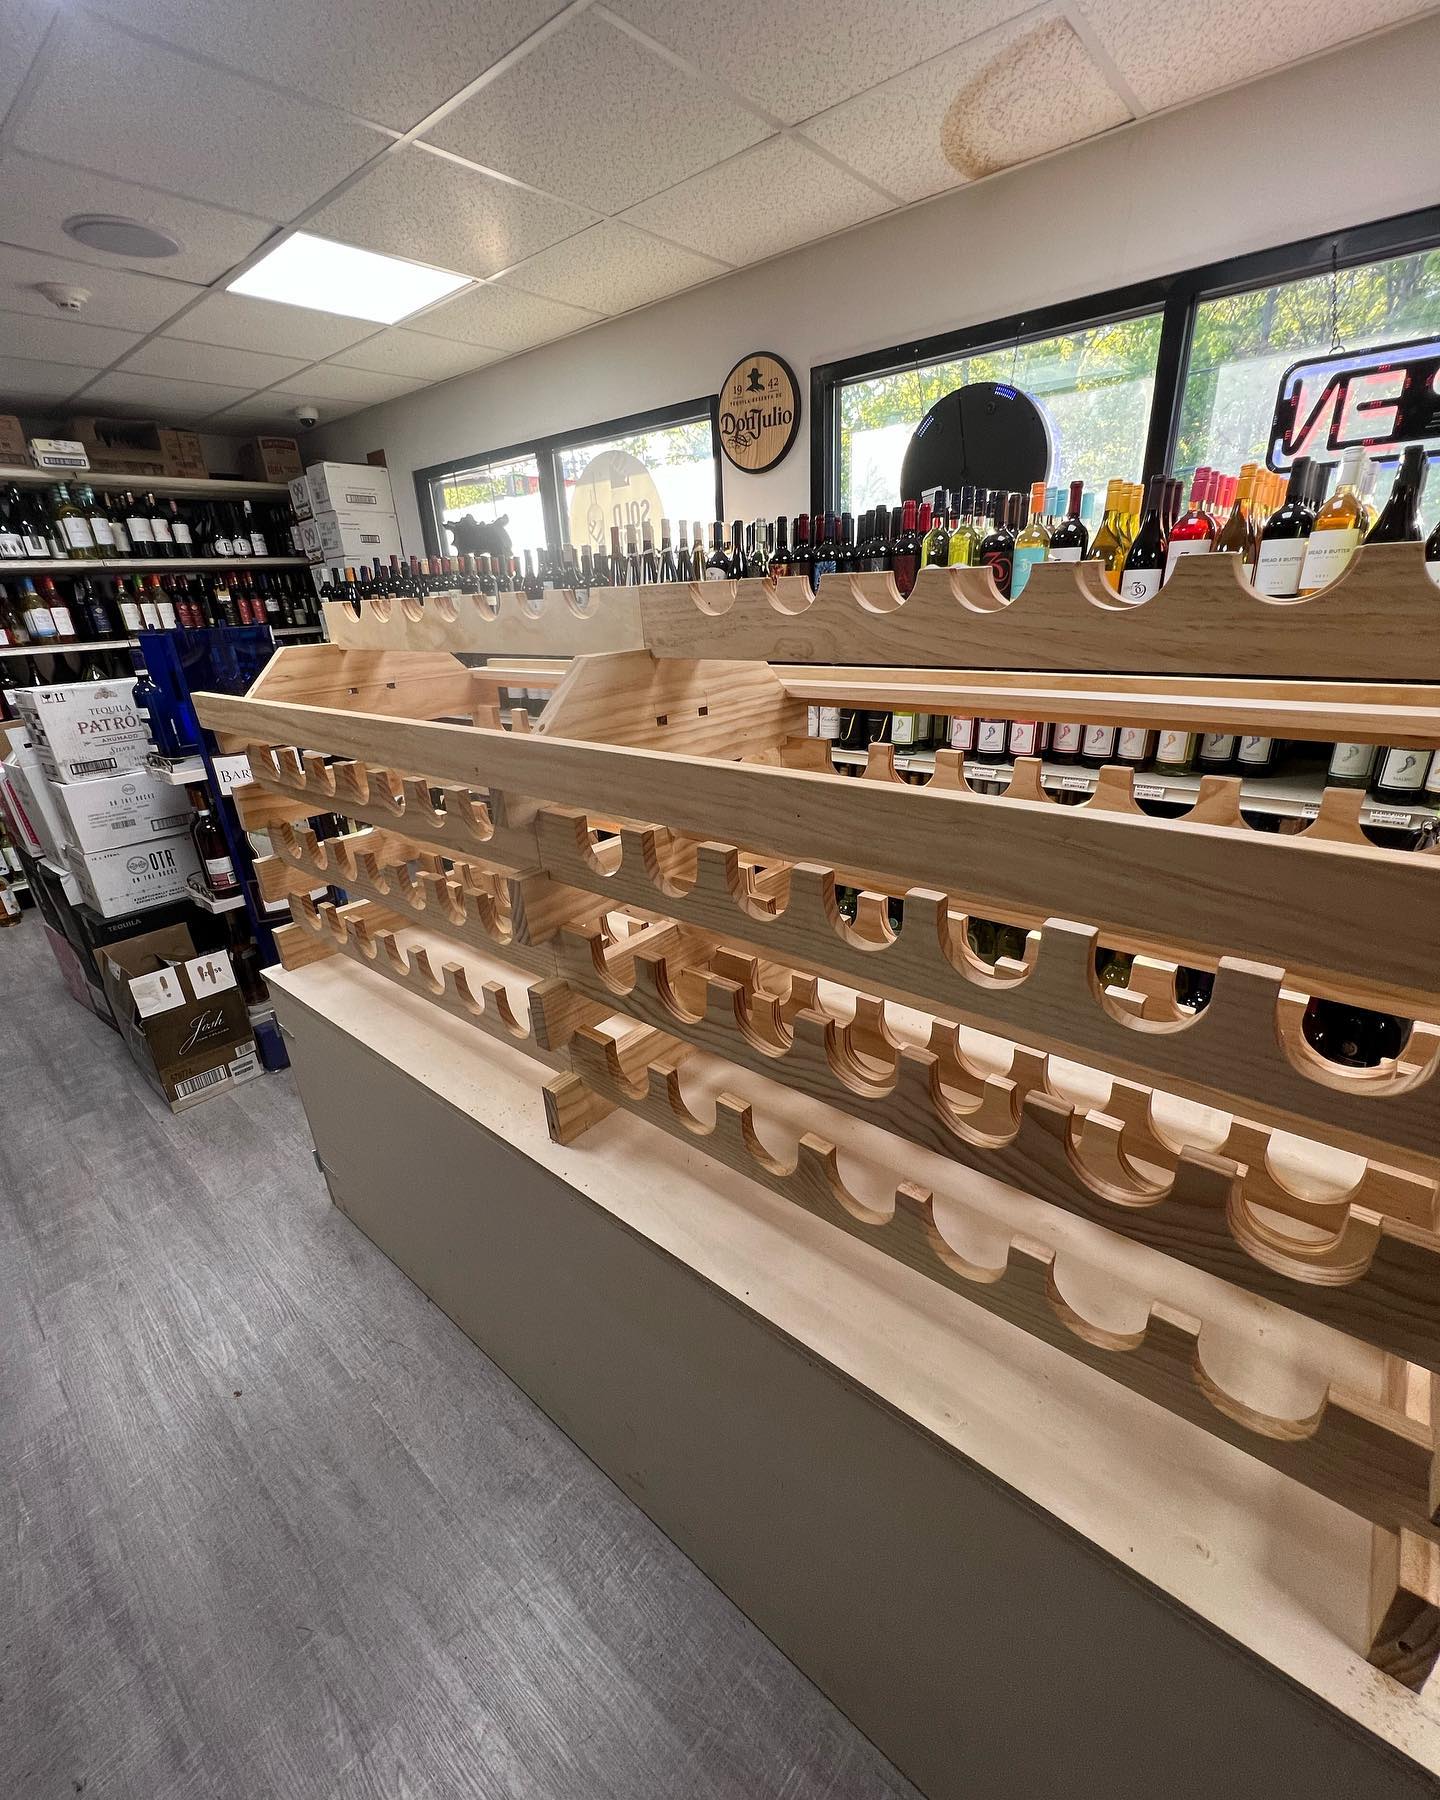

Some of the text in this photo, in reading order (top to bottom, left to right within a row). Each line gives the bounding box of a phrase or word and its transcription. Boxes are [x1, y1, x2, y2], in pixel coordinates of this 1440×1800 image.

[733, 377, 779, 396] 19 42
[88, 704, 132, 716] TEQUILA
[102, 733, 139, 743] AHUMADO
[109, 745, 136, 756] SILVER
[221, 769, 251, 783] BAR
[149, 849, 177, 871] OTR
[107, 918, 142, 933] TEQUILA
[178, 1009, 226, 1056] Josh
